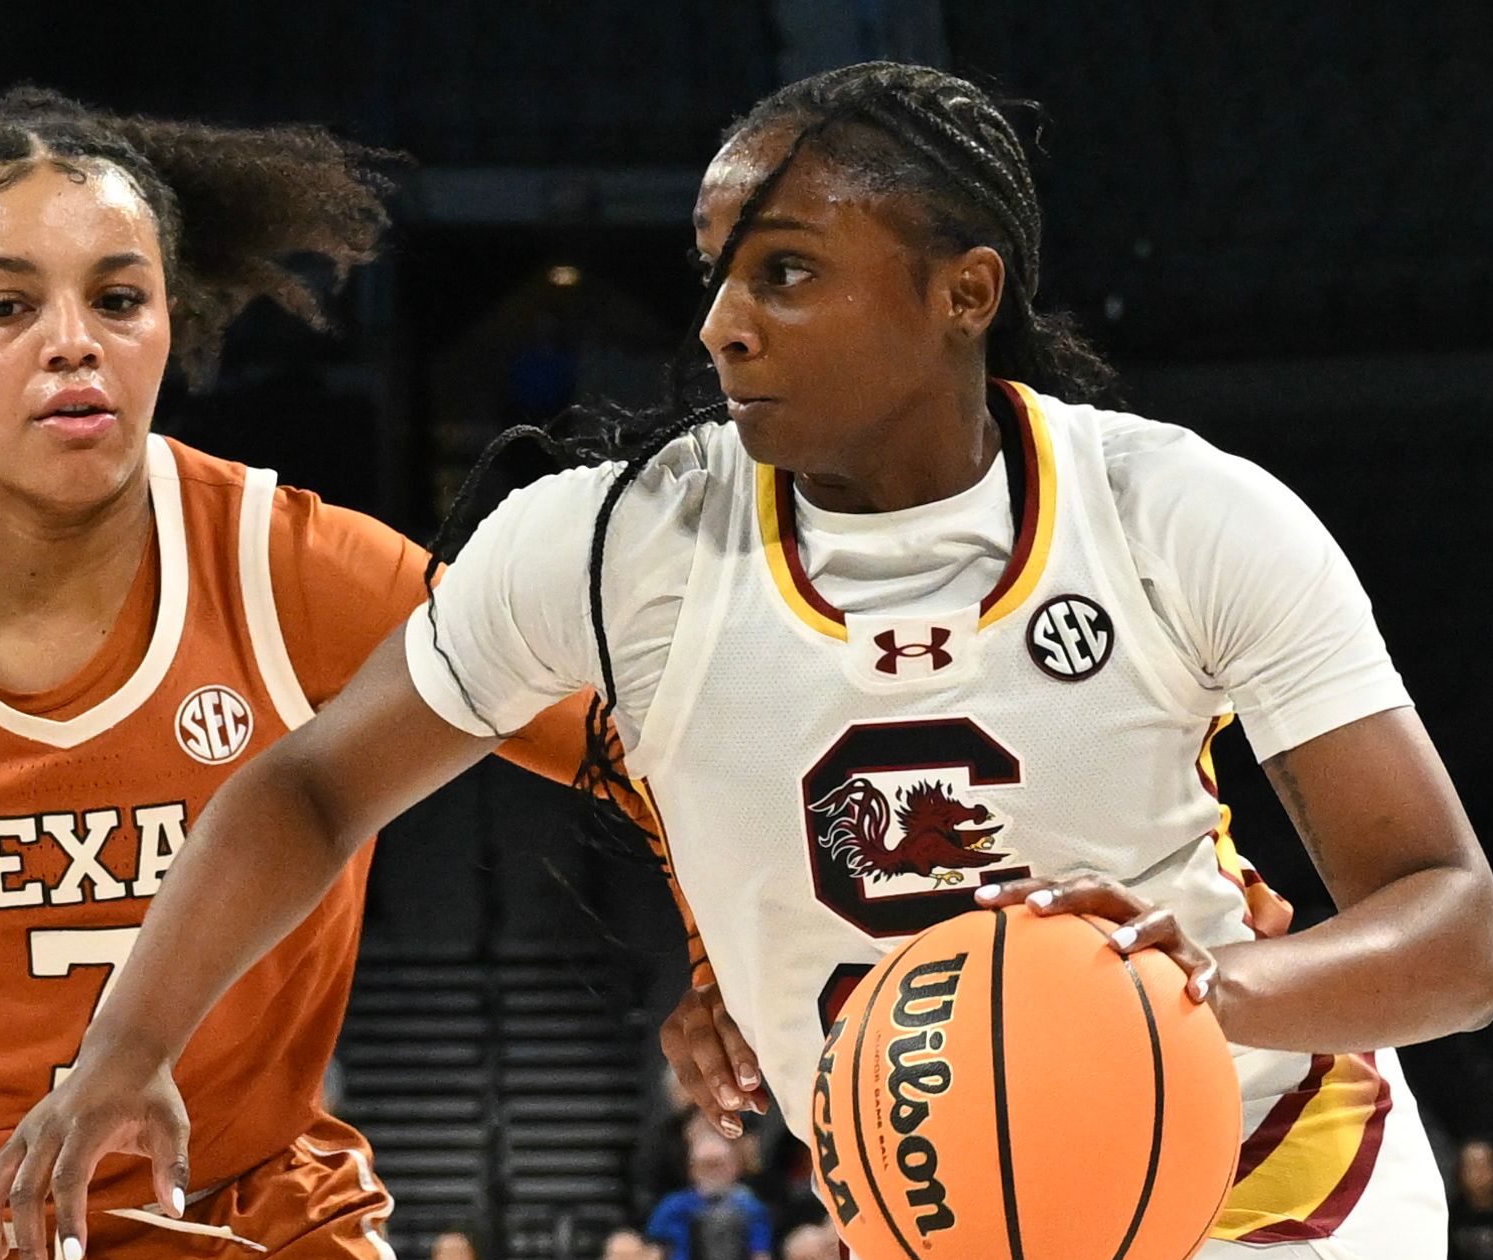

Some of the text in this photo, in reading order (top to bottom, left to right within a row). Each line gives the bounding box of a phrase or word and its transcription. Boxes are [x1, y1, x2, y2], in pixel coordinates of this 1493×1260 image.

[1032, 600, 1108, 675] SEC
[180, 690, 248, 760] SEC
[812, 1016, 860, 1227] NCAA
[874, 1088, 883, 1129] GAME
[887, 951, 969, 1237] Wilson
[878, 1135, 889, 1171] BALL
